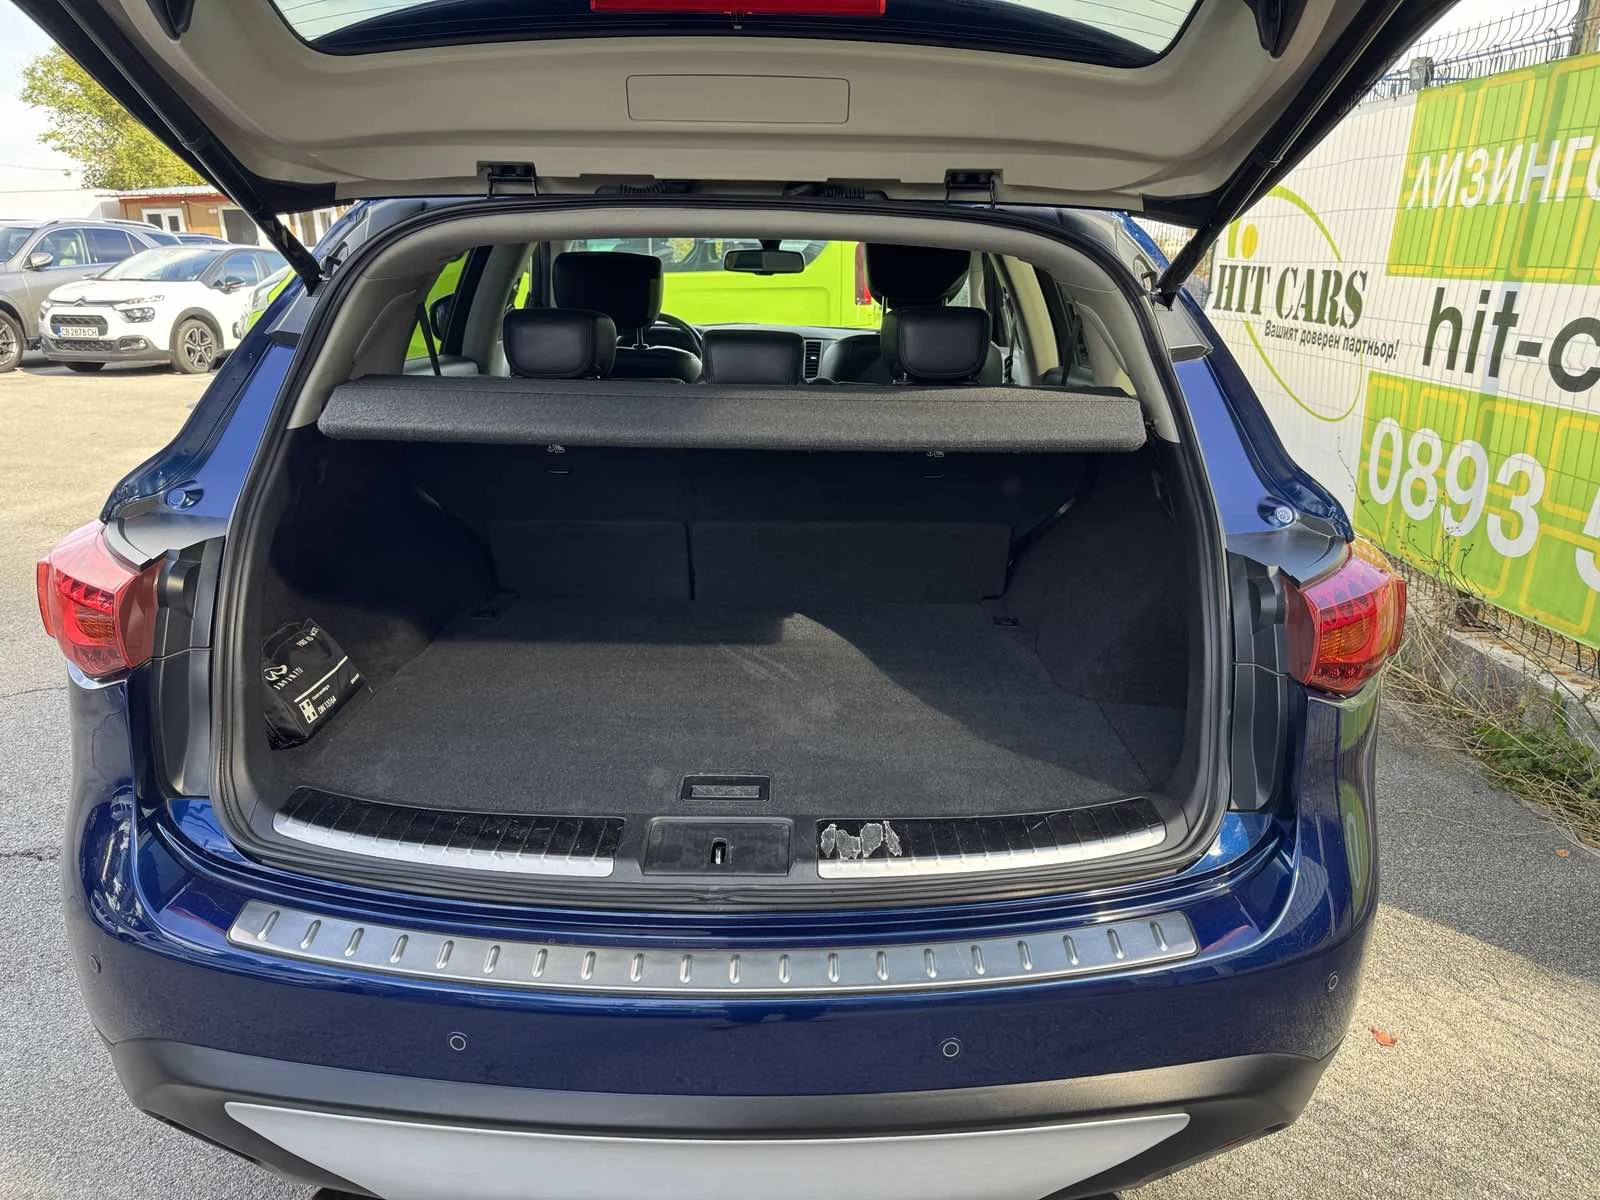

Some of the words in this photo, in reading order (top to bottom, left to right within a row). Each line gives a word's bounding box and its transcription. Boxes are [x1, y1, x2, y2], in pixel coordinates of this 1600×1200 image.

[1213, 264, 1271, 315] HIT
[1275, 266, 1368, 329] CARS
[1422, 286, 1600, 393] hit-c
[1264, 320, 1299, 342] Вашият
[1300, 330, 1340, 351] доверен
[1343, 336, 1400, 361] партньор!
[1369, 417, 1546, 558] 0893
